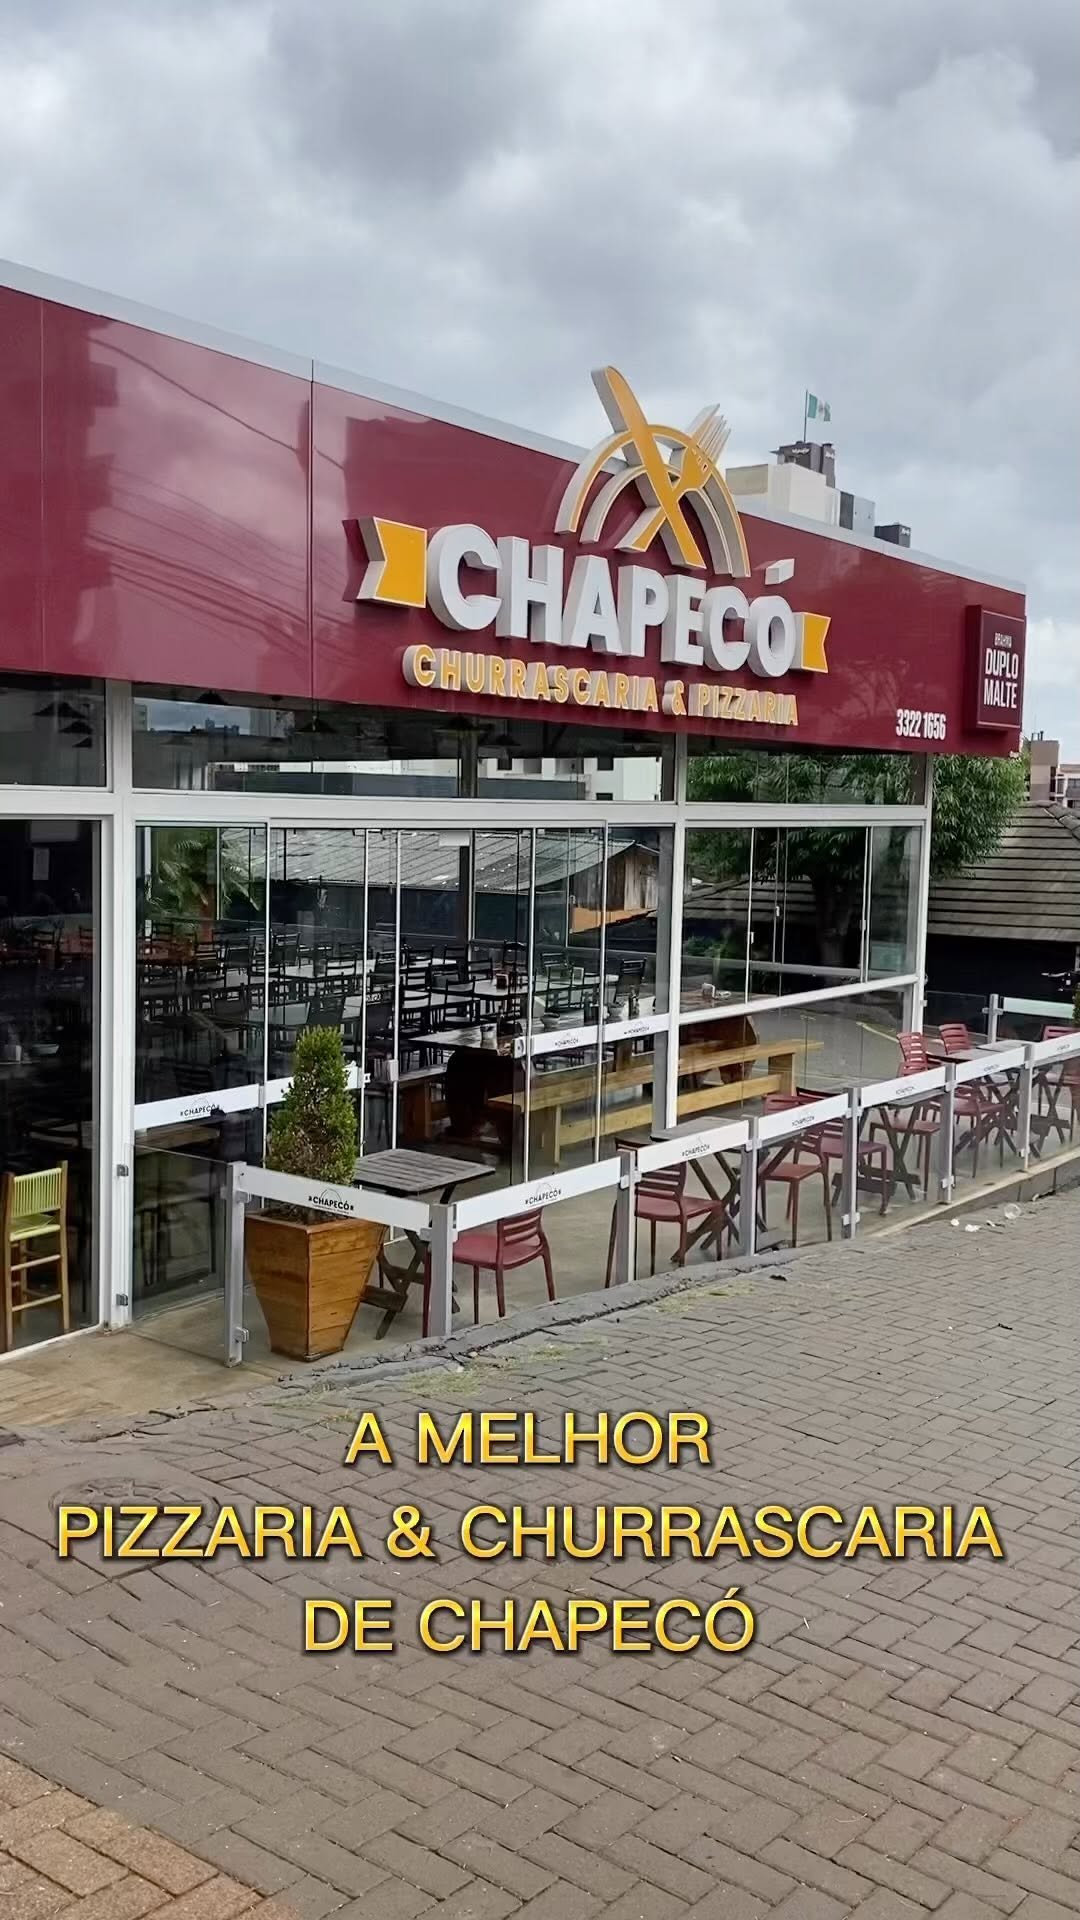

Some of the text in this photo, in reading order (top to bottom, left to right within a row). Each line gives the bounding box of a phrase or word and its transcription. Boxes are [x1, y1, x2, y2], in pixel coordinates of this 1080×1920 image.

[427, 523, 795, 678] CHAPECÓ
[985, 647, 1019, 680] DUPLO
[403, 644, 799, 726] CHURRASCARIA & PIZZARIA
[983, 678, 1018, 709] MALTE
[895, 708, 946, 741] 3322 1656
[313, 1196, 350, 1210] CHAPECÓ
